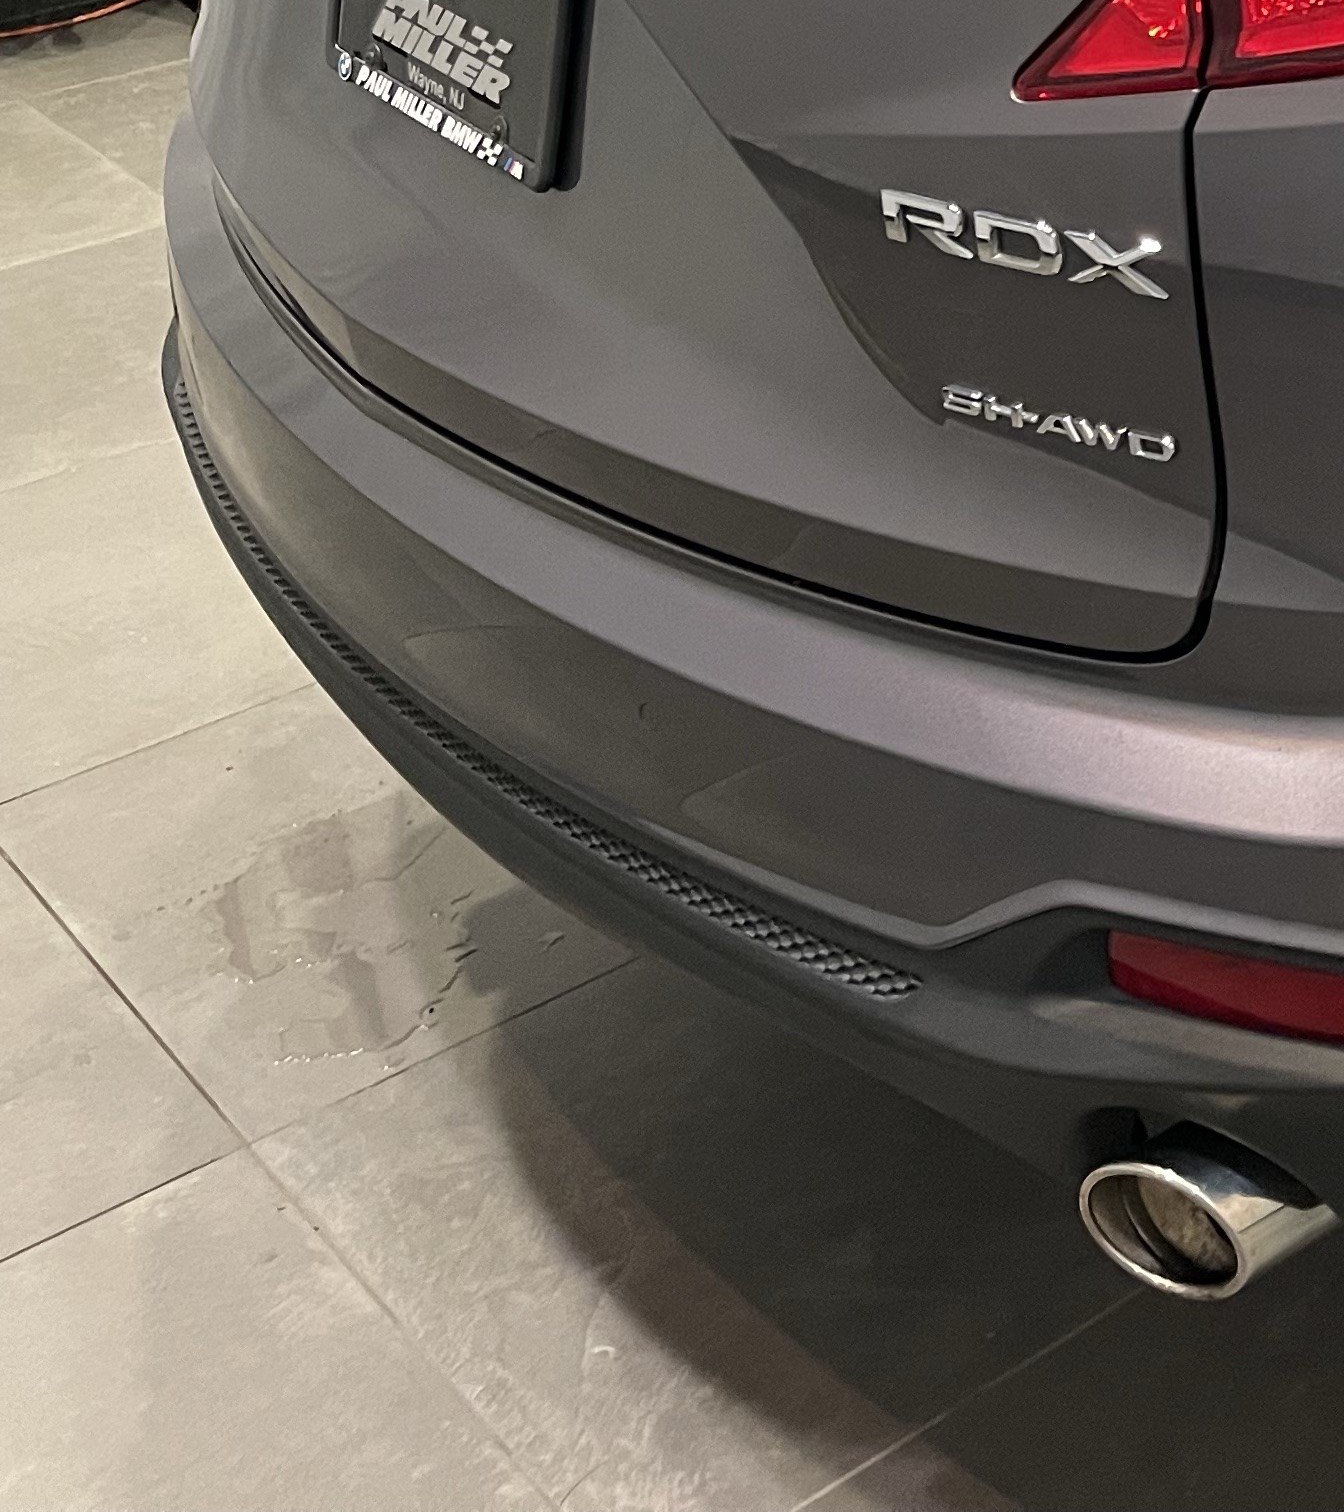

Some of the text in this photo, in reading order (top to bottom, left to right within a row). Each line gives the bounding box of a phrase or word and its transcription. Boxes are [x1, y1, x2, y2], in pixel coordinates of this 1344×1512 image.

[372, 7, 511, 105] MILLER
[406, 61, 466, 111] Wayne, NJ
[355, 64, 483, 154] PAUL MILLER BMW
[880, 188, 1170, 300] RDX
[942, 384, 1176, 462] SH-AWD
